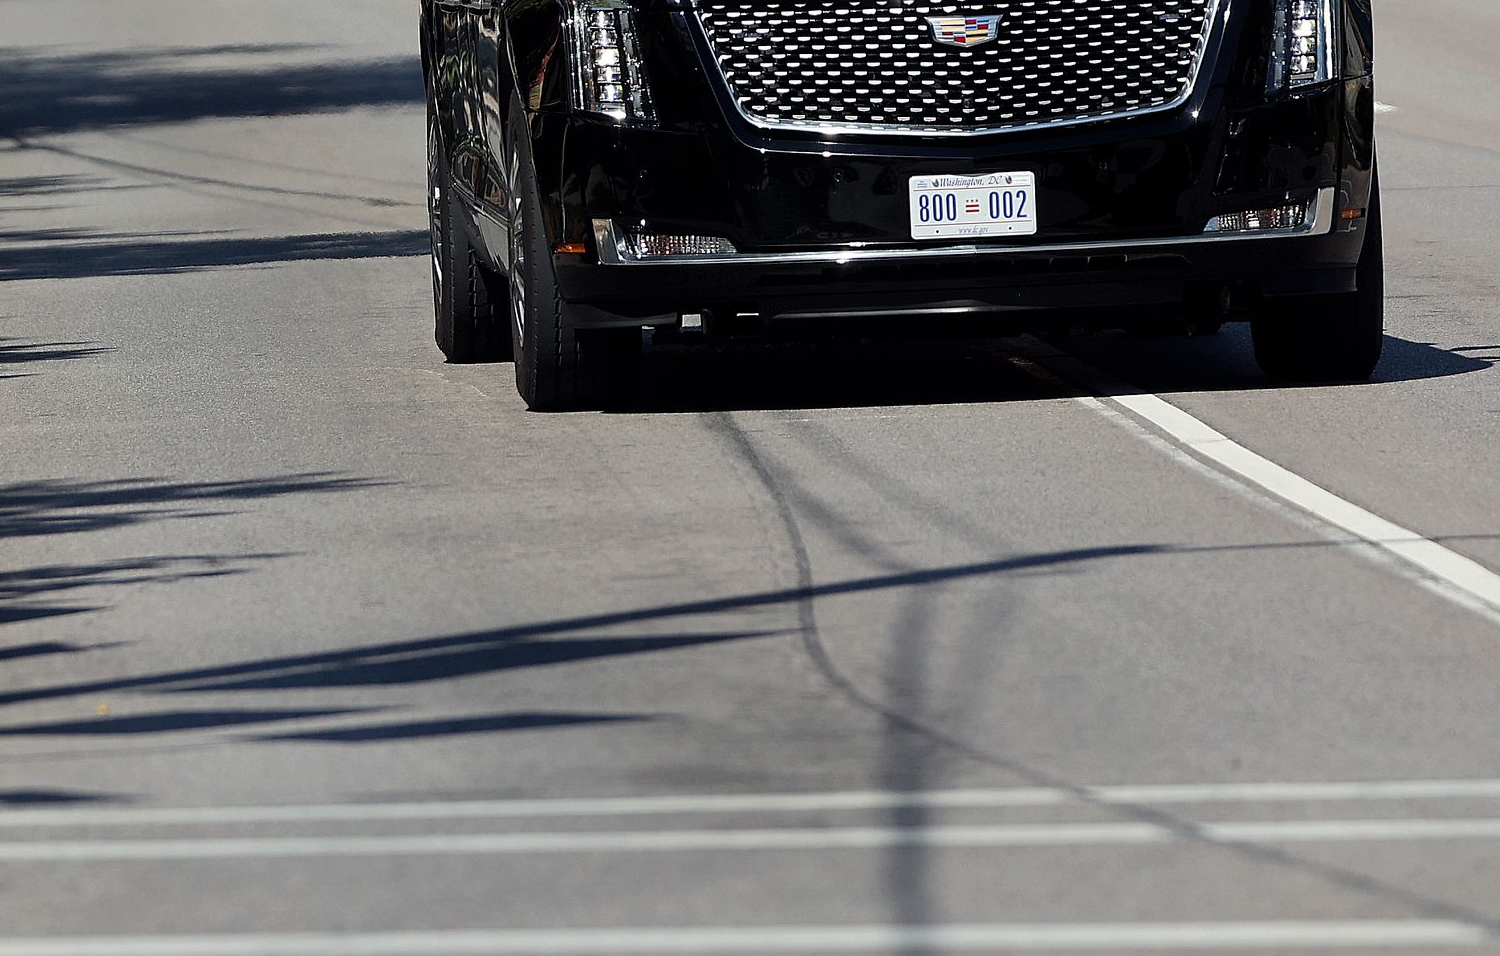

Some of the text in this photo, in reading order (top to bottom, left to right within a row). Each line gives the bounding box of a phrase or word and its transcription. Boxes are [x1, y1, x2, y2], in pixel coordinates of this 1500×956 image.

[938, 176, 985, 188] Washington,
[988, 175, 1003, 185] DC
[919, 190, 1028, 222] 800 002
